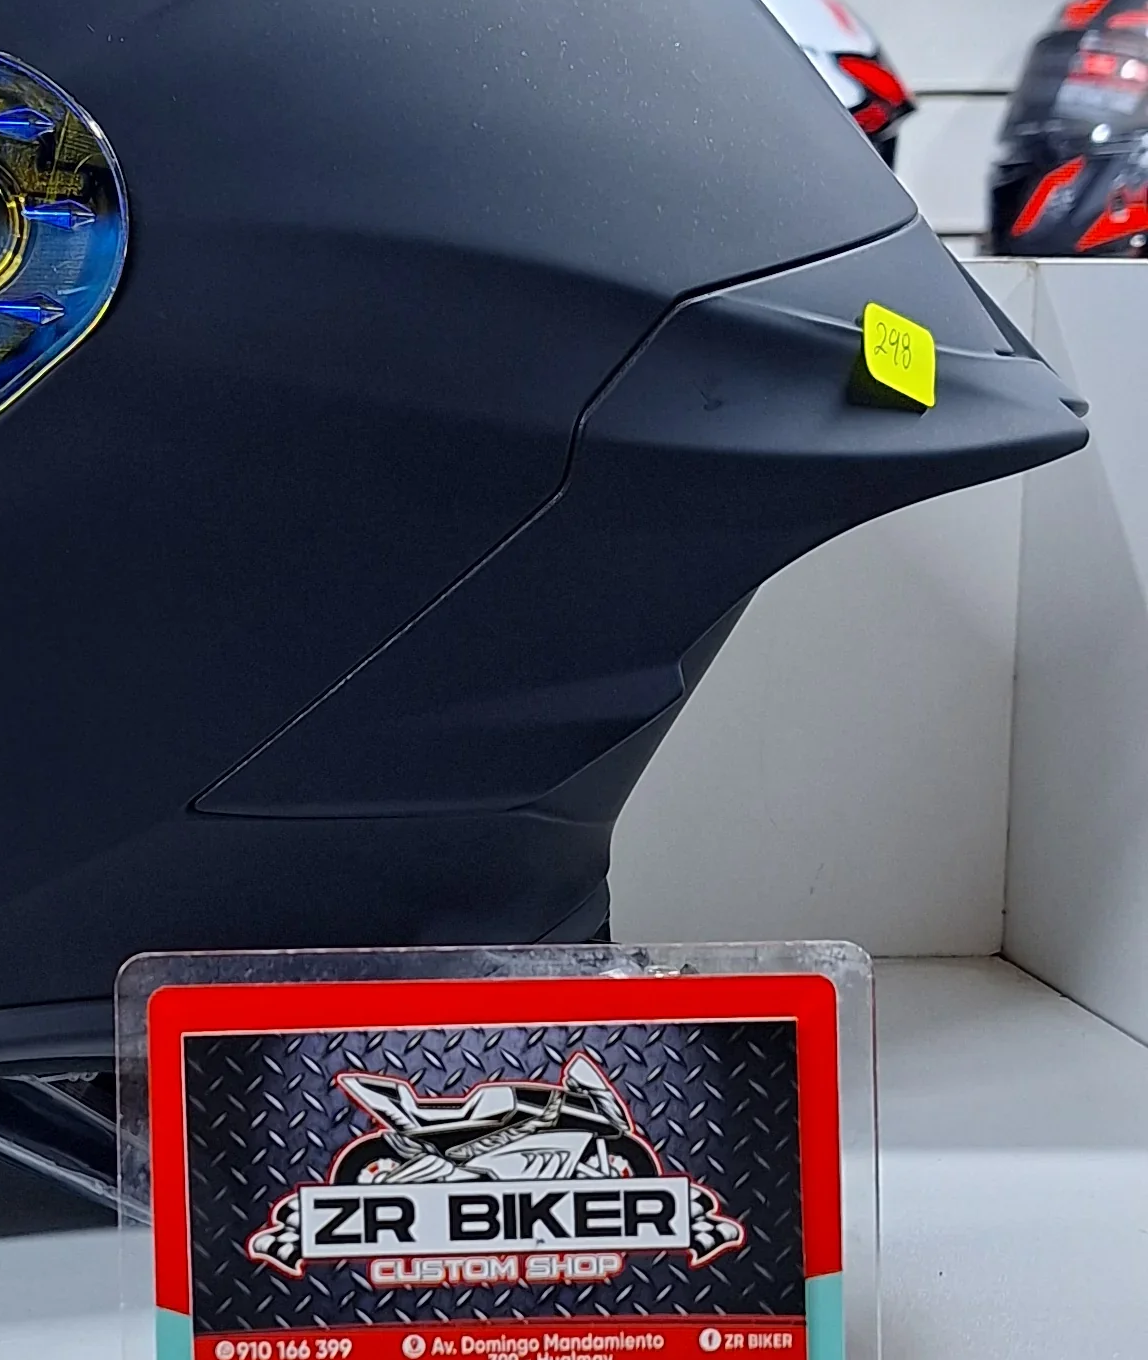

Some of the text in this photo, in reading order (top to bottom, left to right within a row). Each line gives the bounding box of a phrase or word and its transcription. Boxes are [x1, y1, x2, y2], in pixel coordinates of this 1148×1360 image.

[873, 321, 912, 370] 298
[313, 1190, 677, 1245] ZR BIKER
[369, 1252, 623, 1285] CUSTOM SHOP
[276, 1339, 311, 1360] 166
[315, 1337, 353, 1359] 399
[430, 1331, 665, 1357] Av. Domingo Mandamiento
[724, 1332, 793, 1350] ZR BIKER
